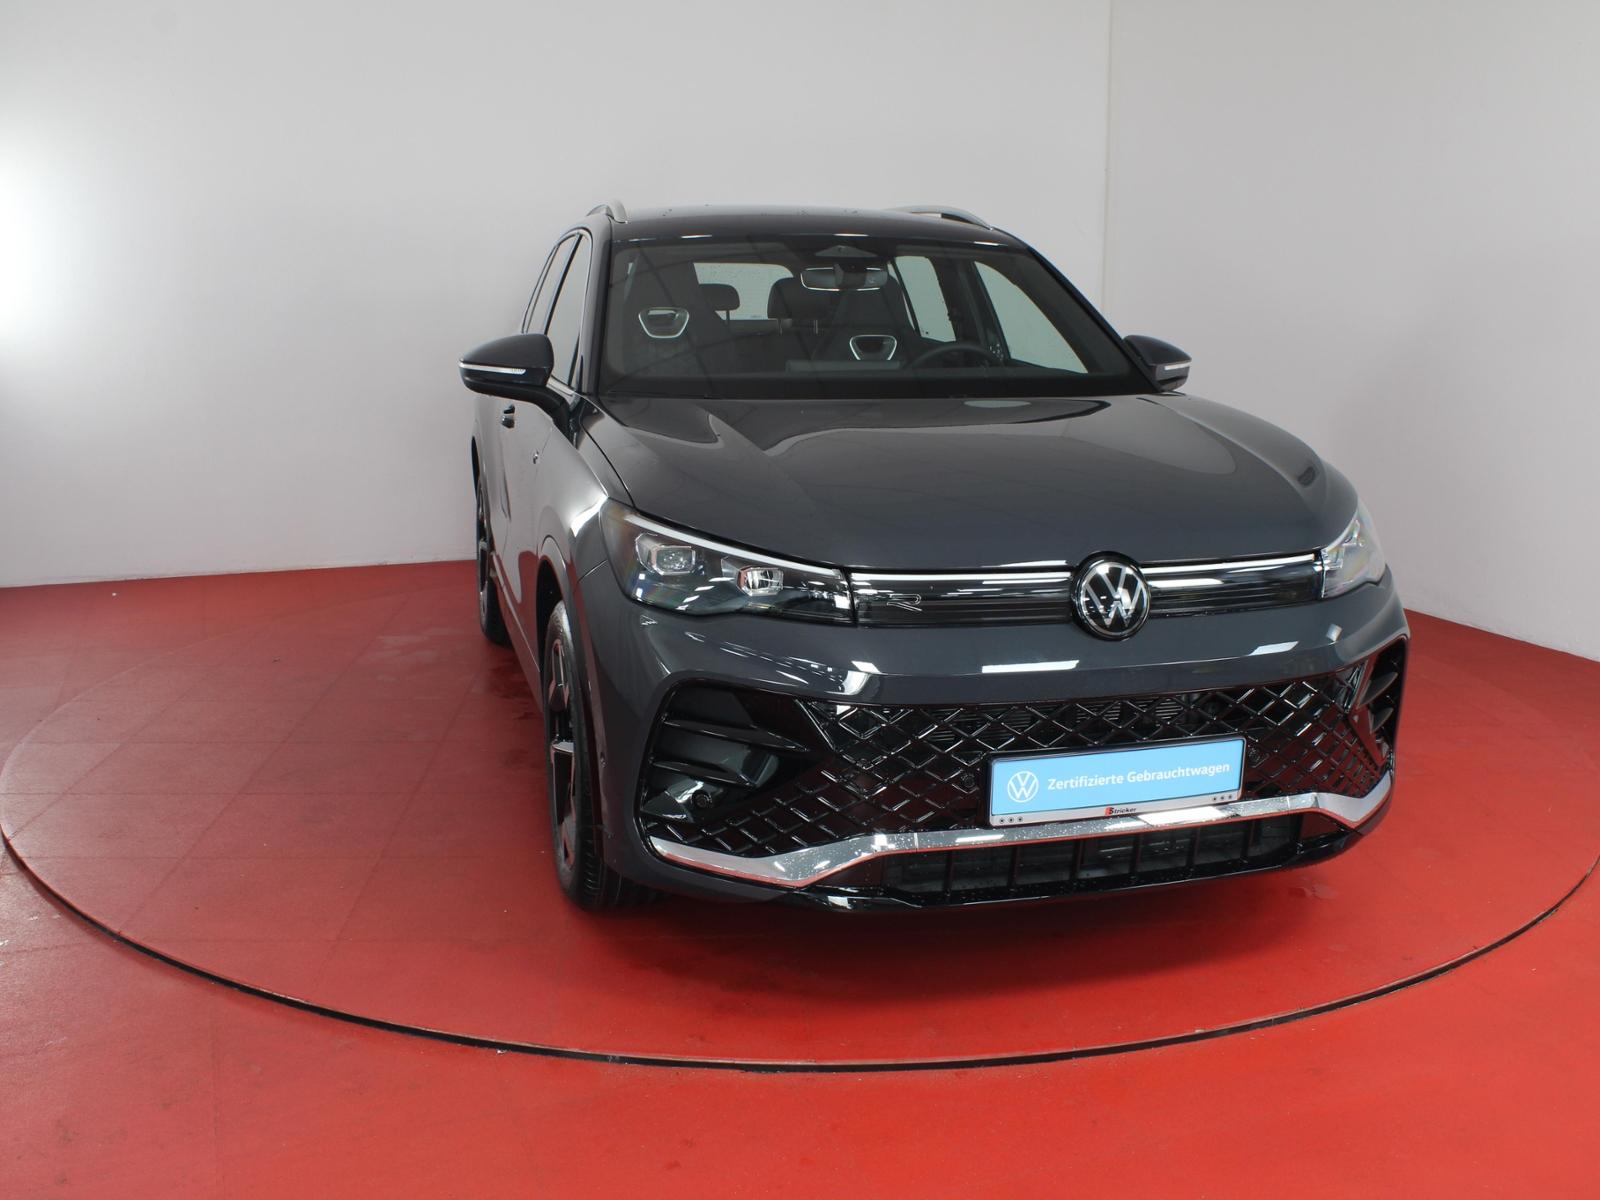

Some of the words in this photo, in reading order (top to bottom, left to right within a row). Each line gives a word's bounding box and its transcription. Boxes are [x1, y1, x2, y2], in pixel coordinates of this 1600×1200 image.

[1080, 561, 1147, 636] VW
[1008, 771, 1038, 802] VW
[1047, 774, 1125, 790] Zertifizierte
[1127, 763, 1230, 783] Gebrauchtwagen
[1107, 805, 1137, 815] Stricker
